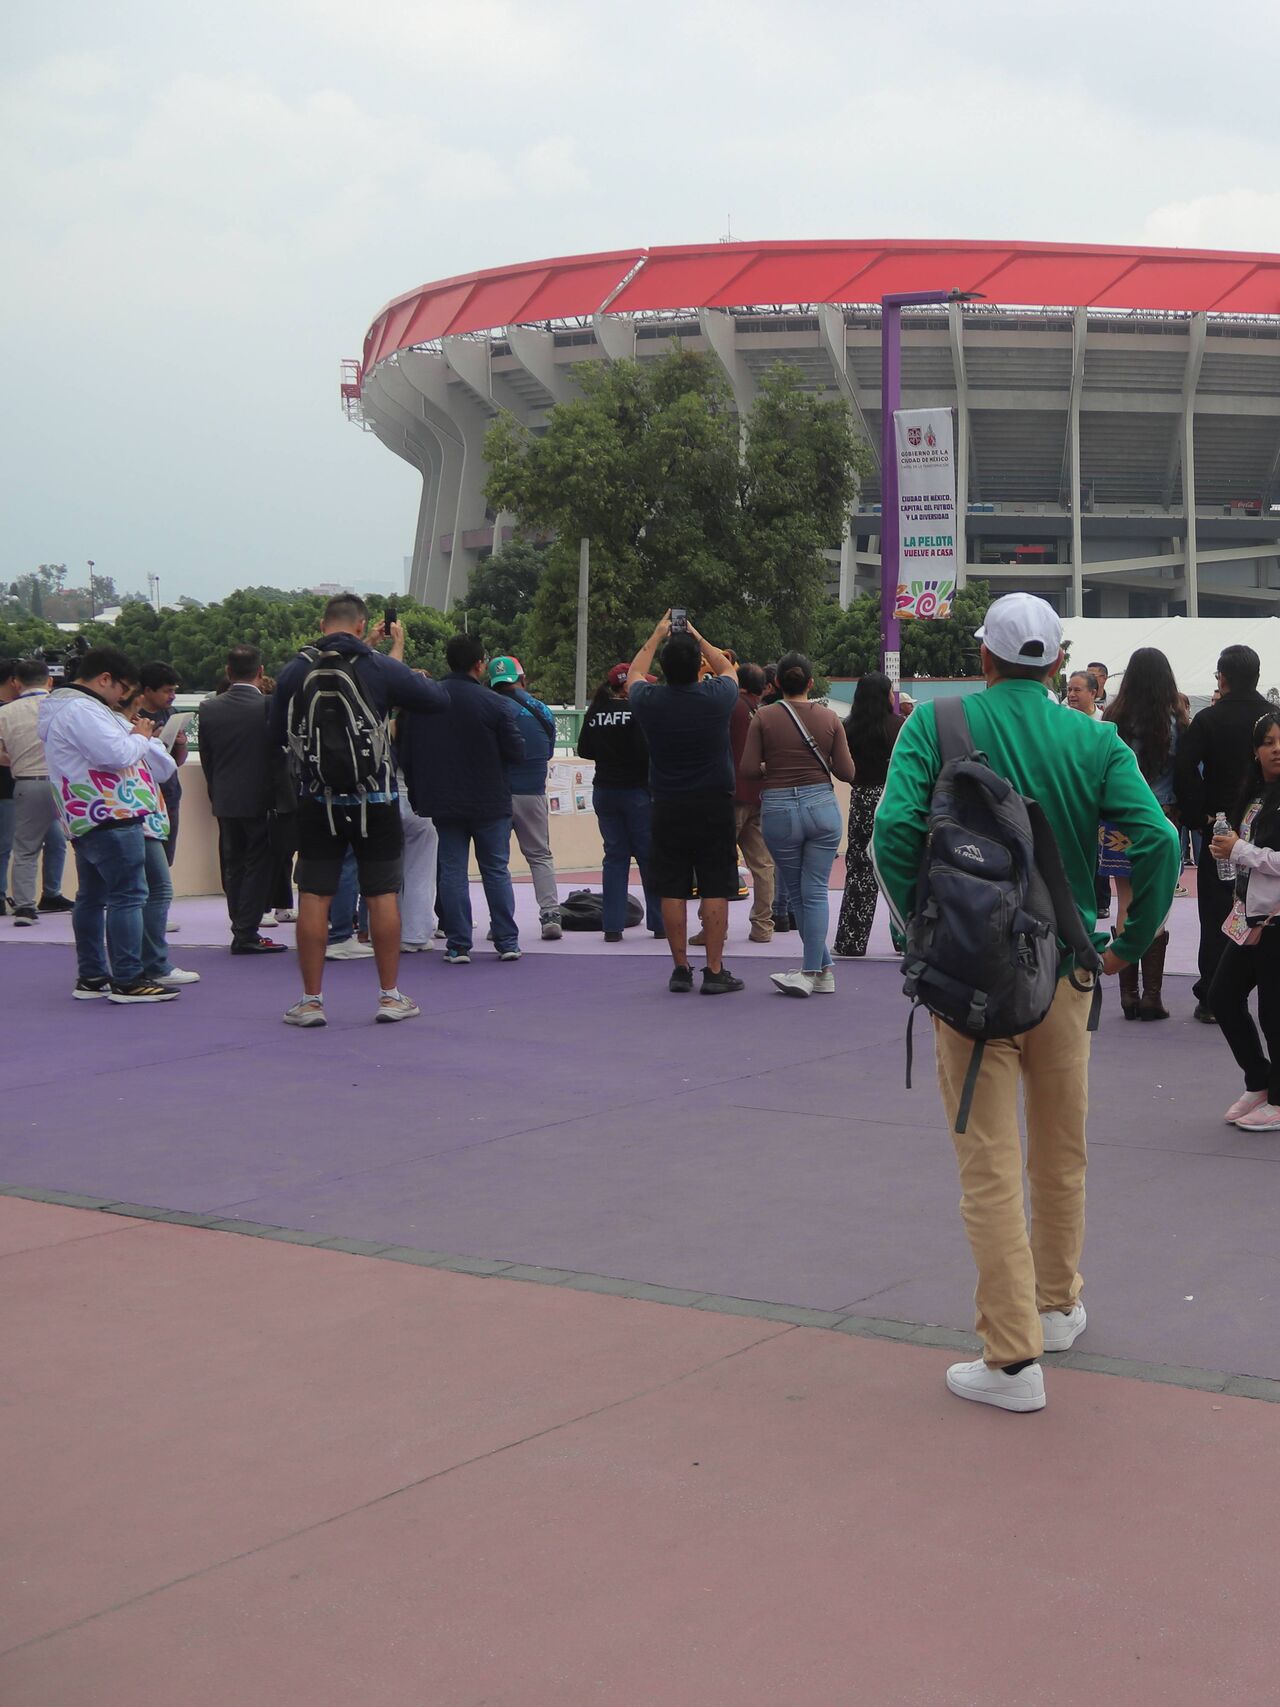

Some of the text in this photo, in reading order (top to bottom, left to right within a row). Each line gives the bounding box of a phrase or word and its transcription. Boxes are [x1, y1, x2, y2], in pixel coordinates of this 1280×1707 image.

[903, 536, 953, 547] LA PELOTA
[904, 549, 929, 557] VUELVE
[936, 548, 953, 556] CASA
